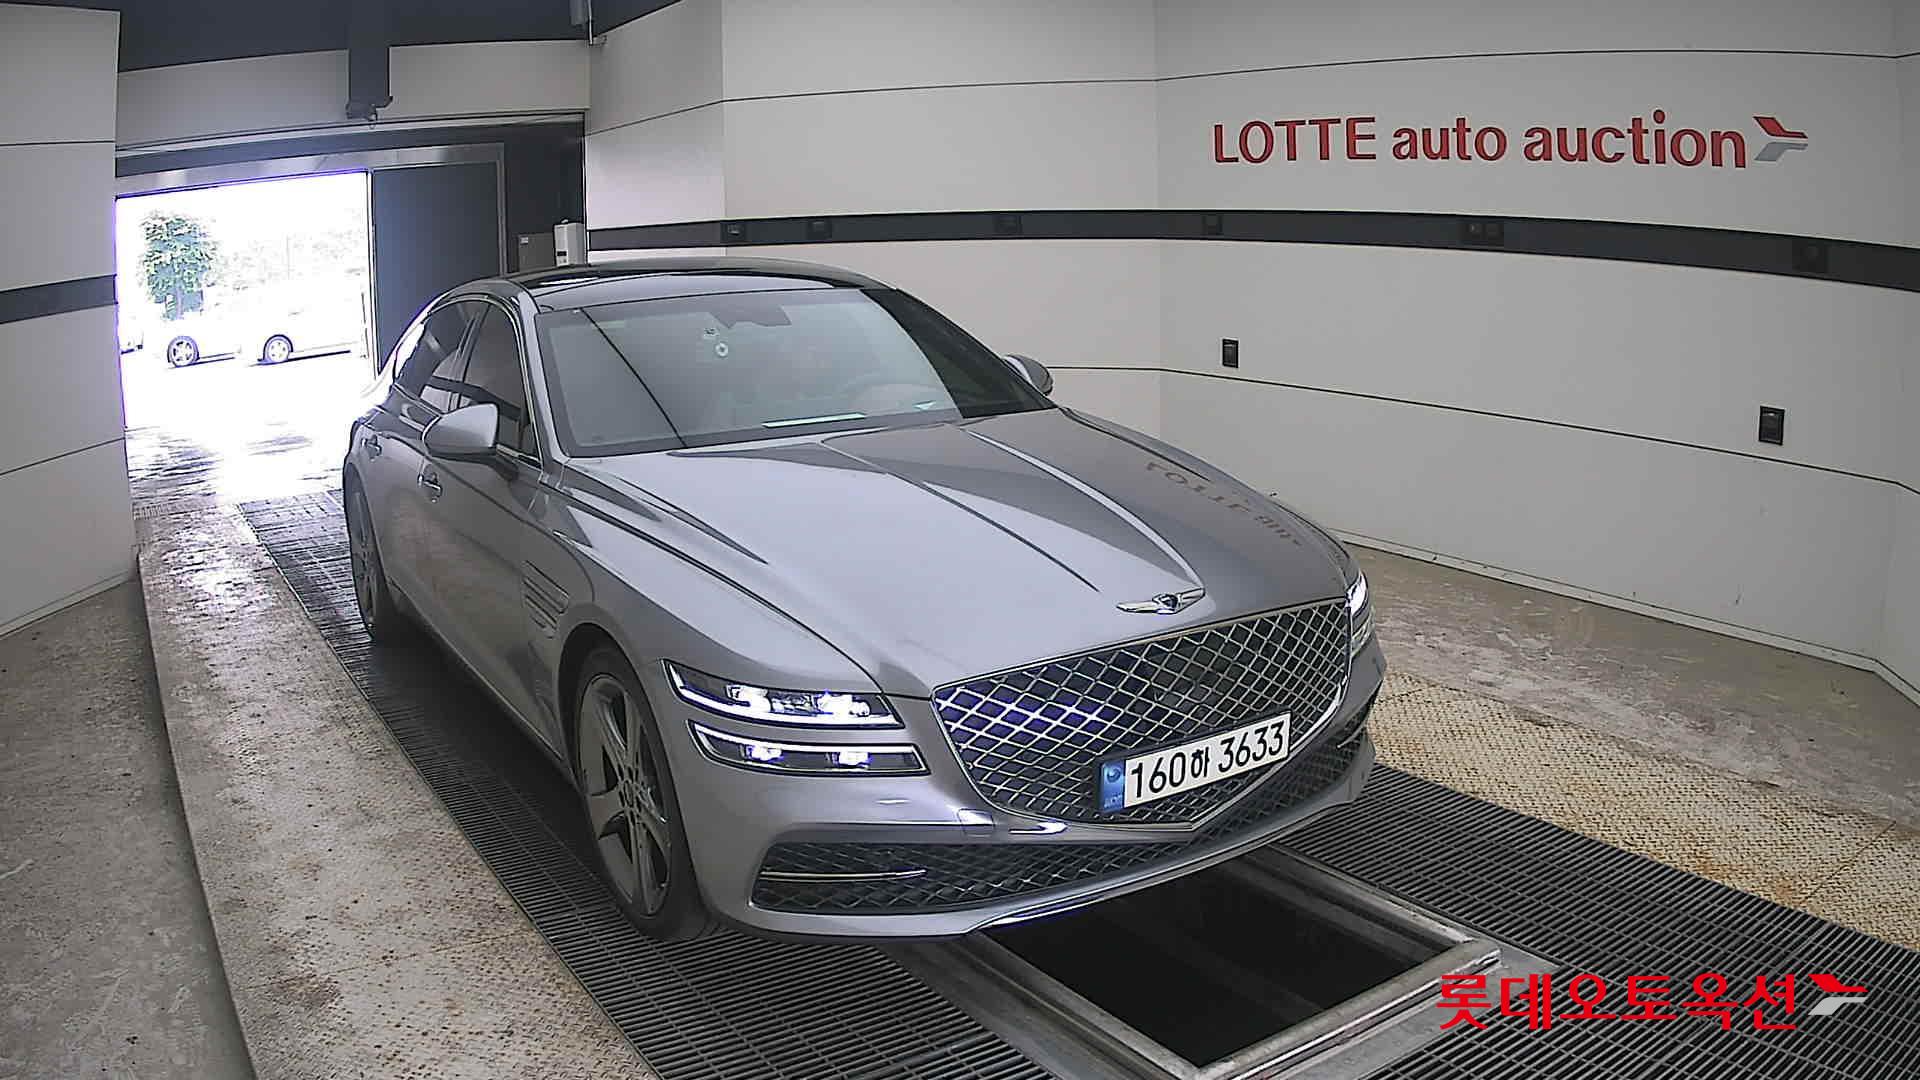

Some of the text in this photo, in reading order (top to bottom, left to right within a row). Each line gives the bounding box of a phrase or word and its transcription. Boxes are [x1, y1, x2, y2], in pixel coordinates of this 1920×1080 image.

[1214, 109, 1746, 168] LOTTE auto auction
[1131, 721, 1285, 798] 160하 3633
